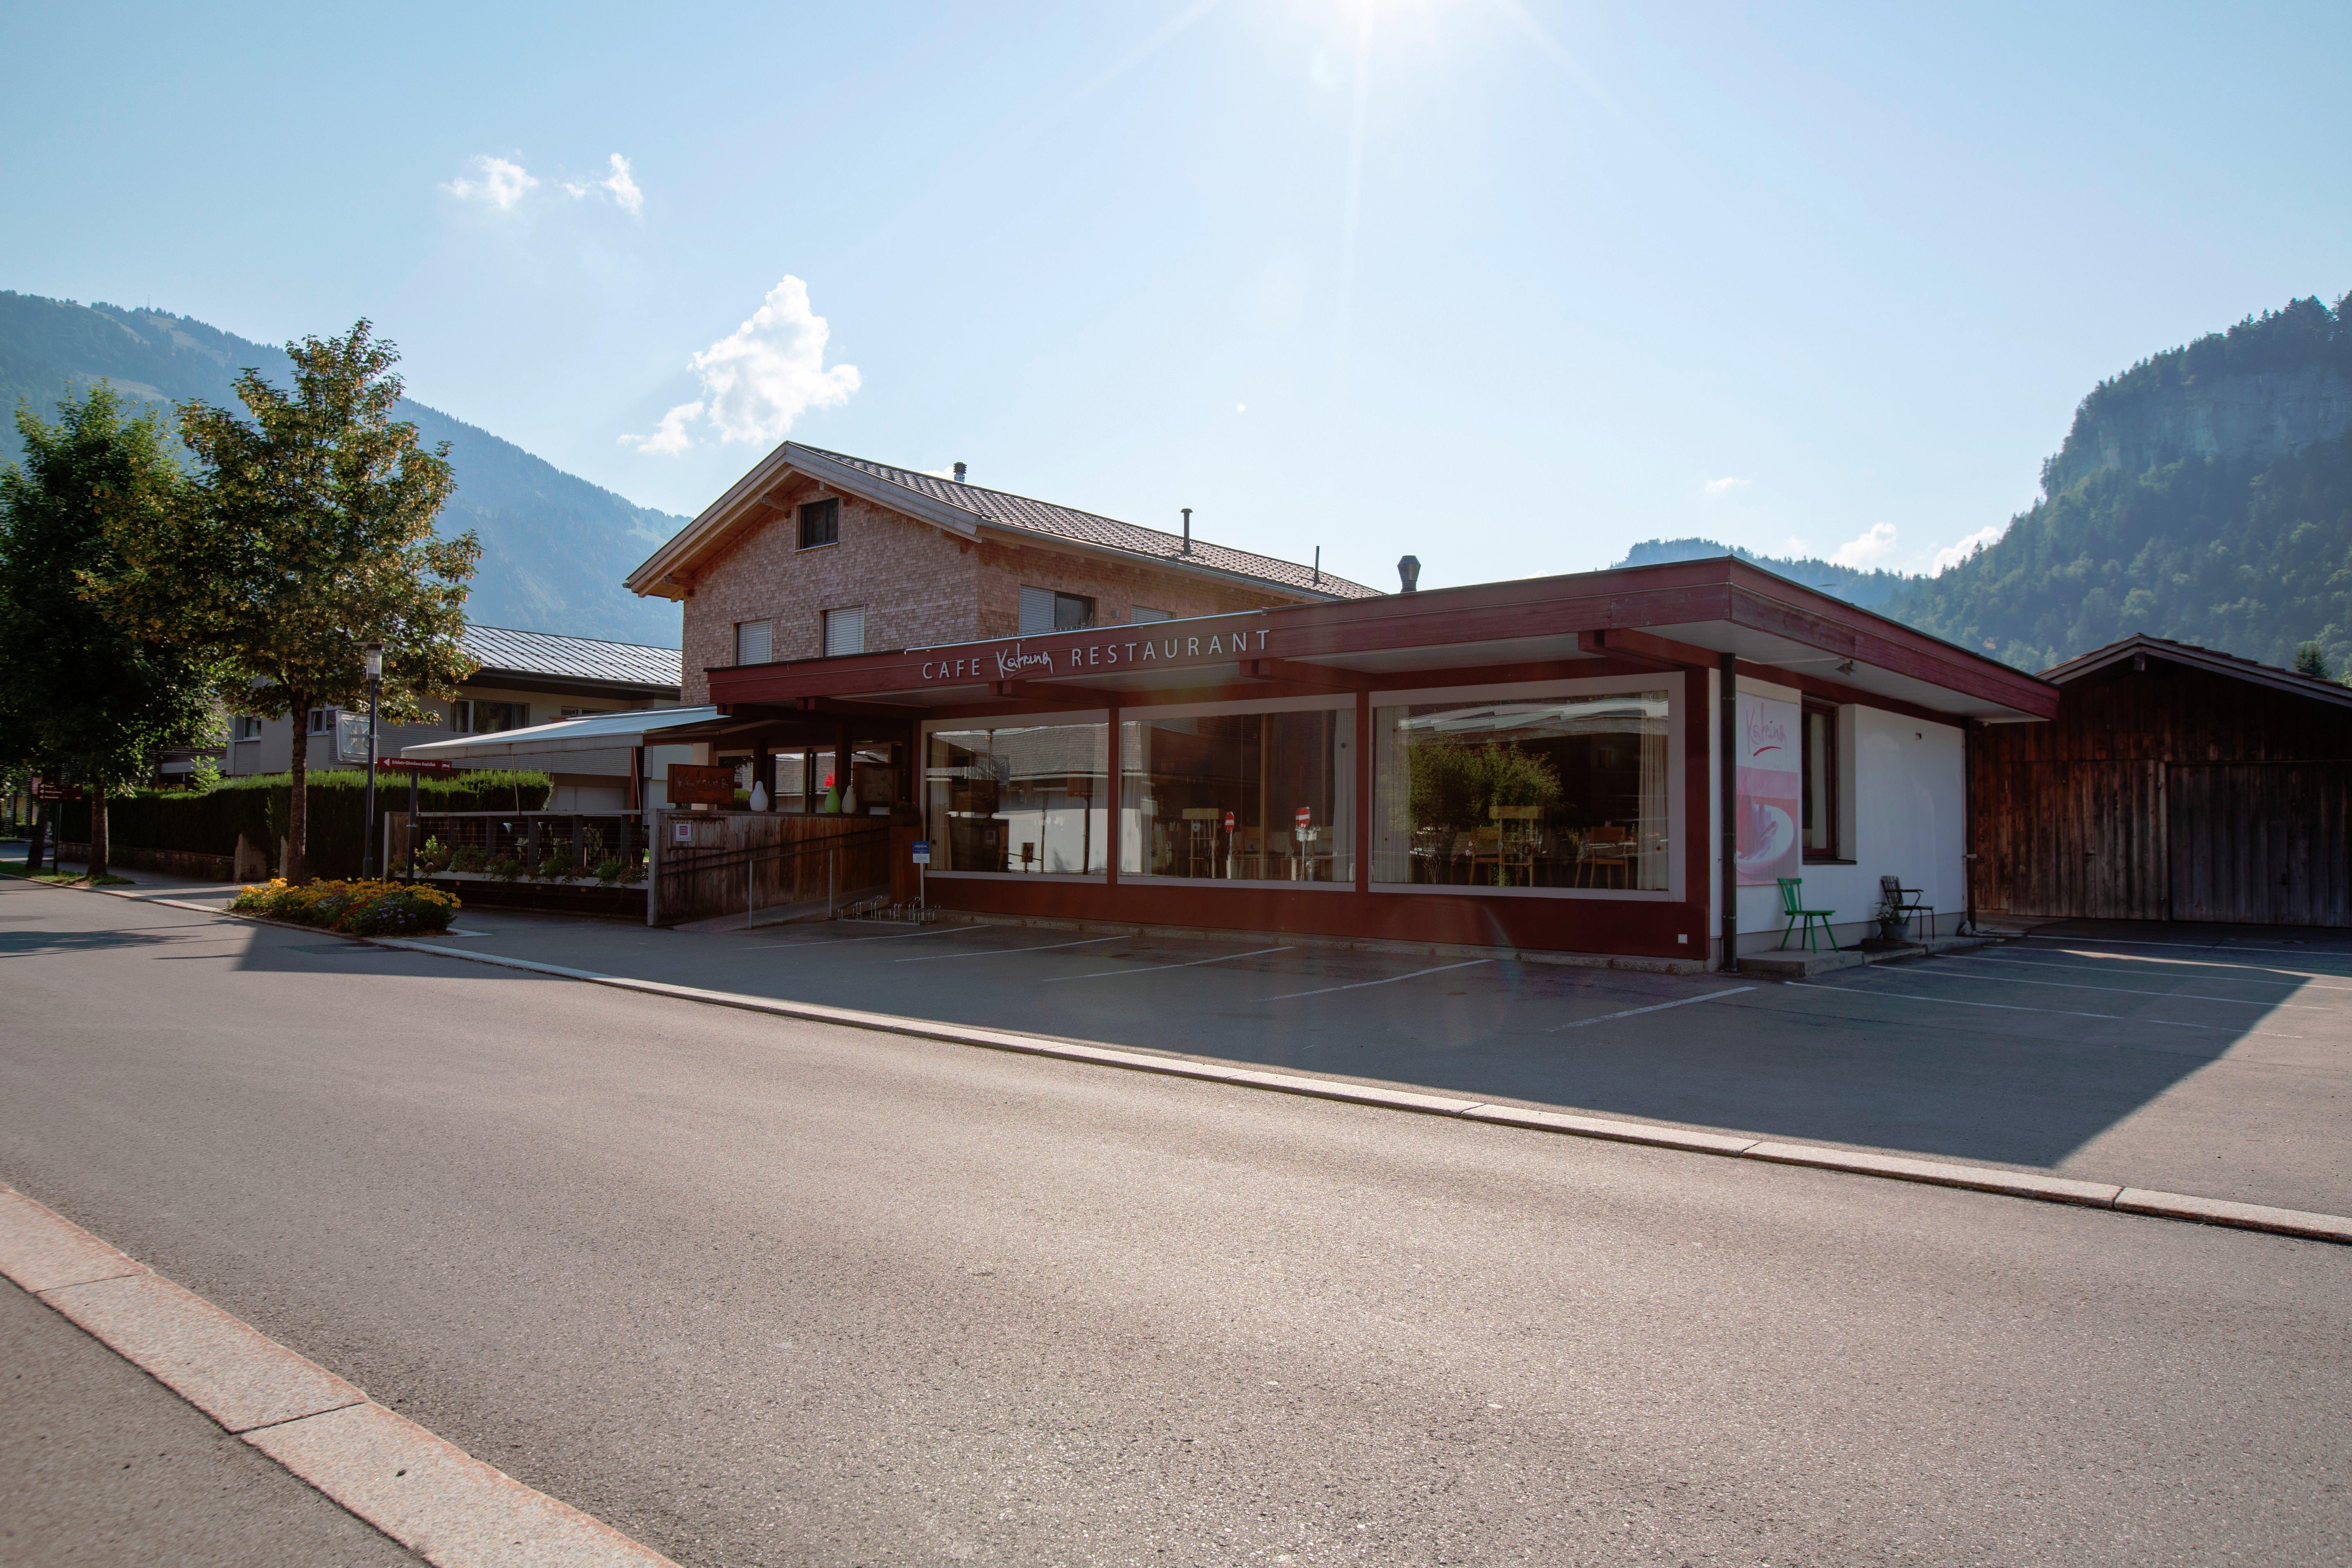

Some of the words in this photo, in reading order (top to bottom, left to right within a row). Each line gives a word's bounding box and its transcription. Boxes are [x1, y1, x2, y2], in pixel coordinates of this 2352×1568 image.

[922, 658, 981, 680] CAFE
[996, 642, 1054, 679] Katrina
[1071, 629, 1271, 667] RESTAURANT
[1746, 702, 1787, 756] Katrina
